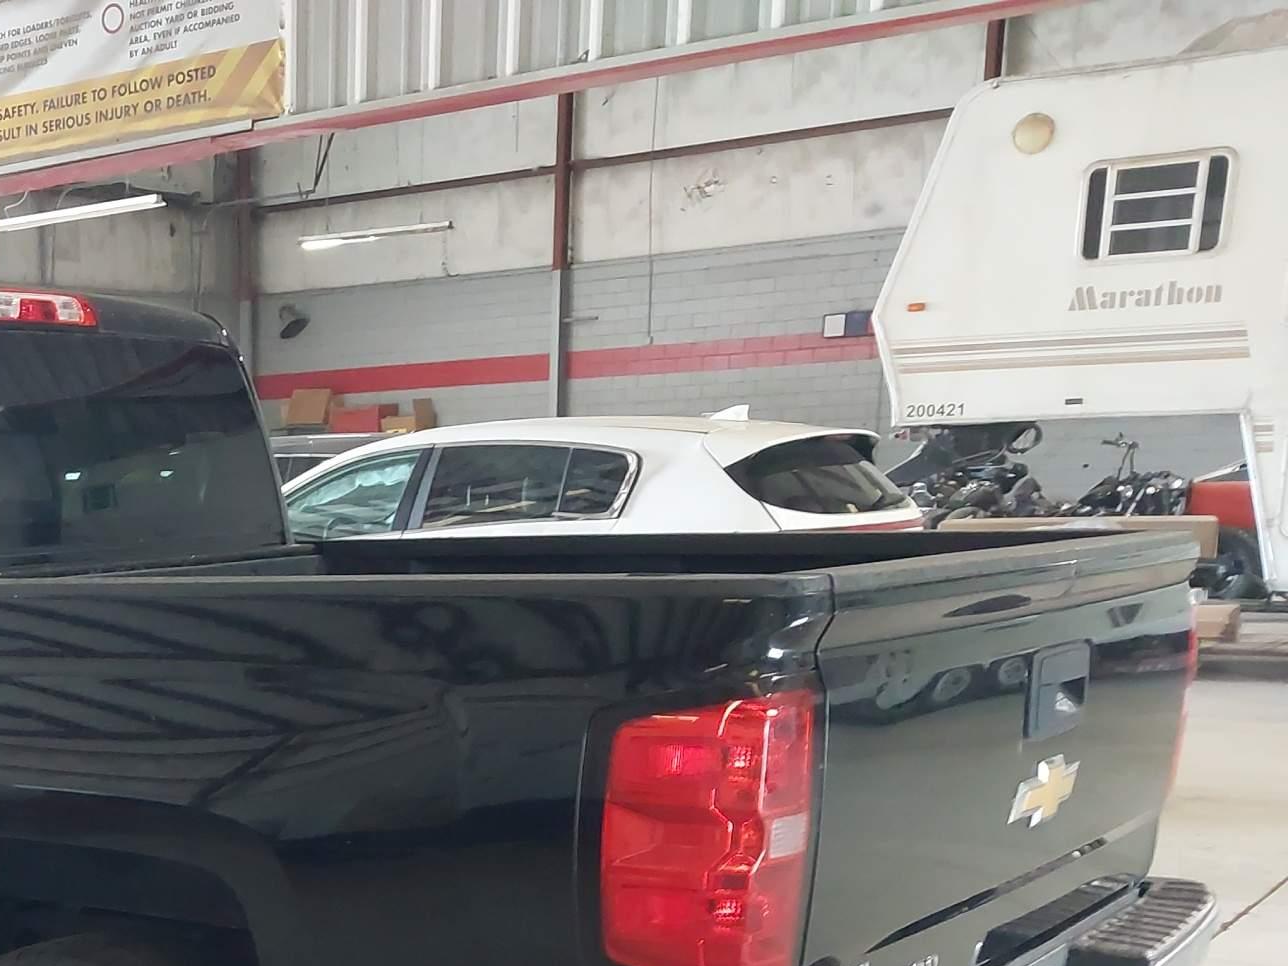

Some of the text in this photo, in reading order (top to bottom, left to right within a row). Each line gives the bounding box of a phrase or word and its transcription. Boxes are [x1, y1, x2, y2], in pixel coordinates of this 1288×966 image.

[129, 1, 234, 34] AUCTION YARD OR BIDDING
[130, 11, 145, 21] NOT
[146, 3, 173, 17] PERMIT
[8, 28, 21, 38] FOR
[153, 29, 172, 40] EVEN
[174, 26, 181, 35] IF
[183, 14, 240, 34] ACCOMPANIED
[7, 49, 31, 62] POINTS
[141, 46, 153, 56] AN
[154, 40, 178, 53] ADULT
[43, 91, 88, 112] FAILURE
[91, 87, 107, 102] TO
[112, 75, 164, 98] FOLLOW
[167, 64, 217, 87] POSTED
[25, 123, 38, 136] IN
[42, 112, 92, 133] SERIOUS
[95, 102, 140, 123] INJURY
[144, 99, 162, 114] OR
[166, 90, 211, 109] DEATH.
[1067, 280, 1223, 312] Marathon
[906, 403, 965, 418] 200421
